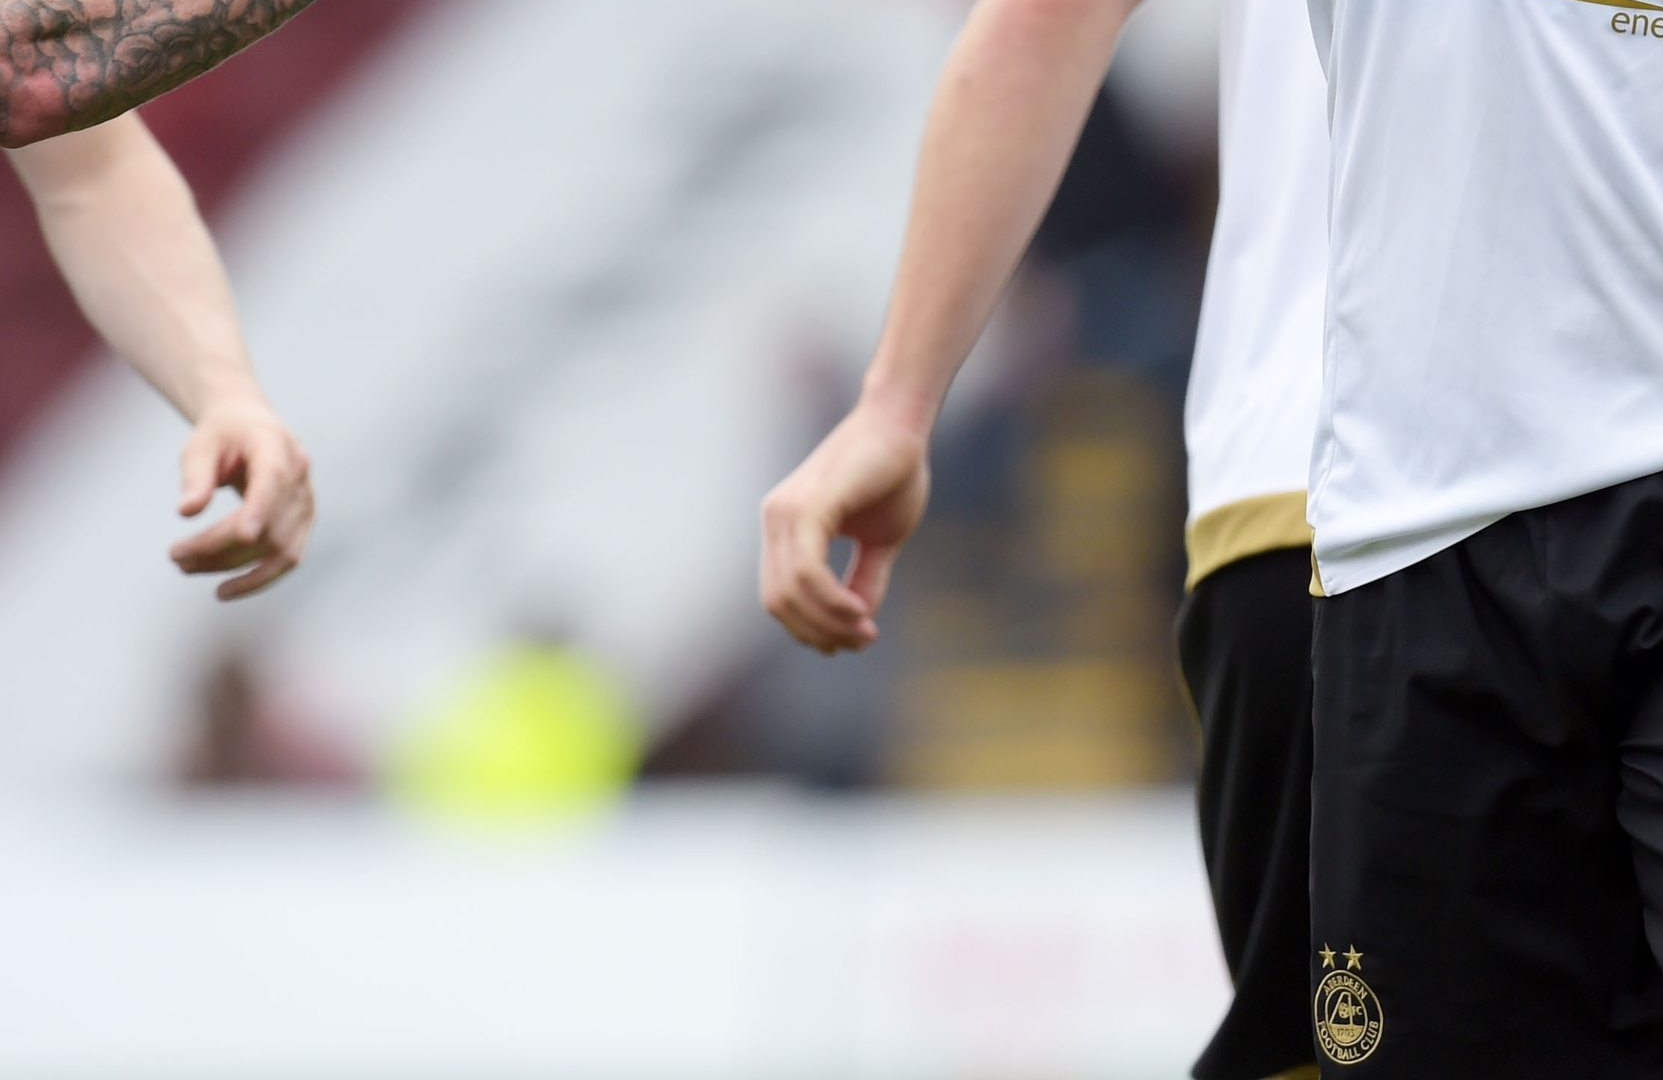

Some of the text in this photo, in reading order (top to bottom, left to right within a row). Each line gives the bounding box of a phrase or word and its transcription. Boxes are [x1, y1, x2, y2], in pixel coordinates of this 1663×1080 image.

[1323, 975, 1368, 1000] ABERDEEN
[1318, 1020, 1379, 1060] FOOTBALL CLUB
